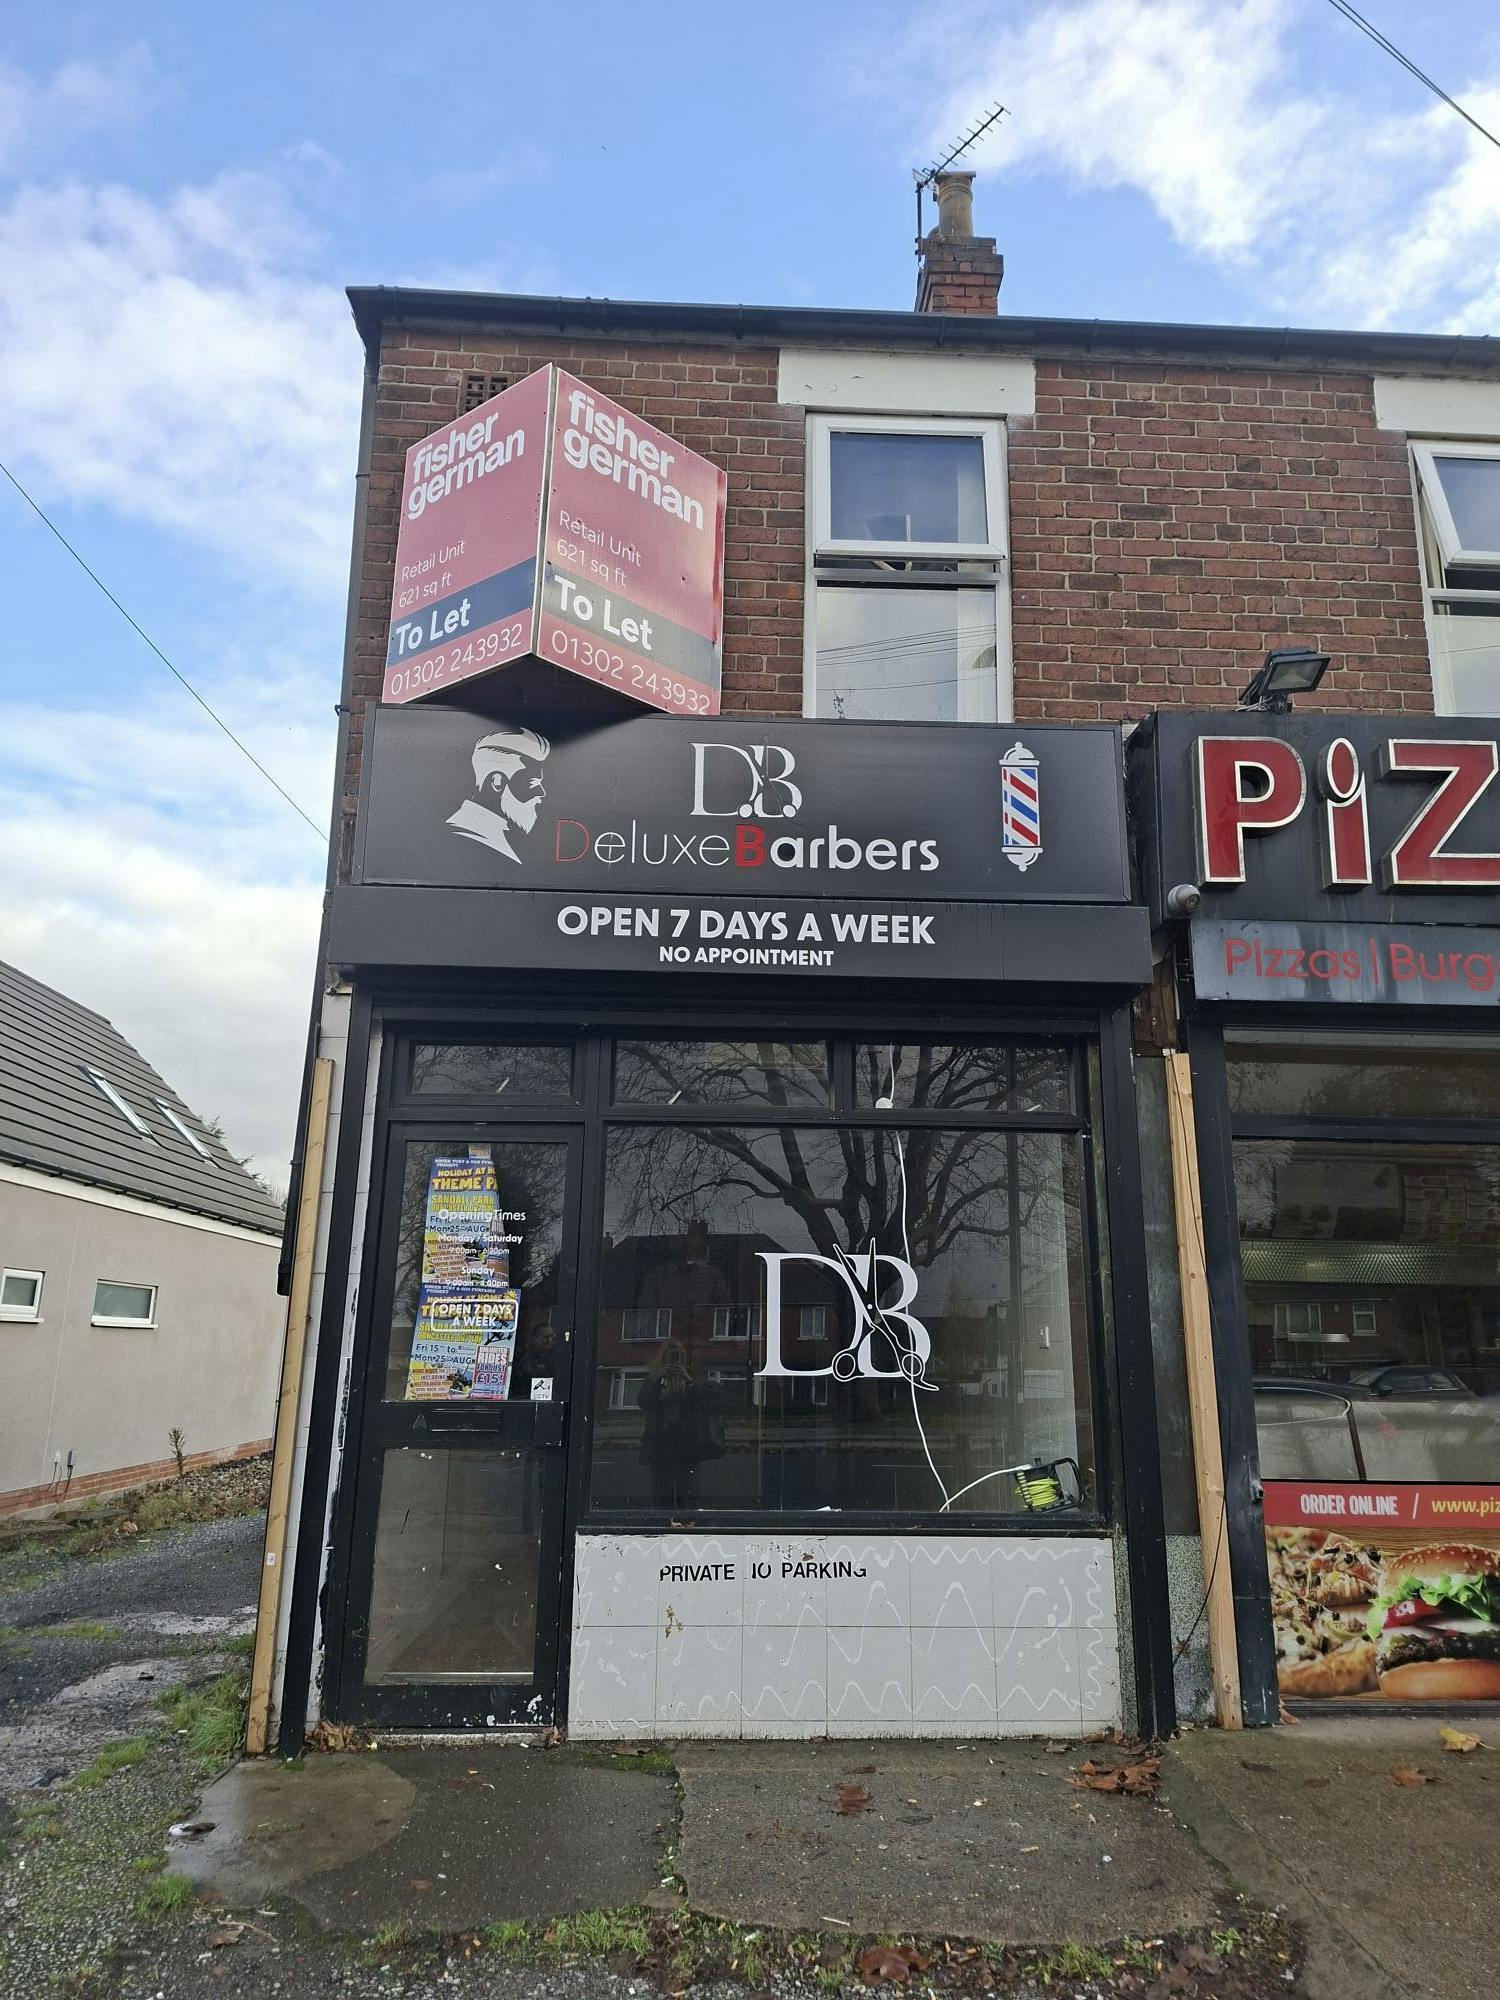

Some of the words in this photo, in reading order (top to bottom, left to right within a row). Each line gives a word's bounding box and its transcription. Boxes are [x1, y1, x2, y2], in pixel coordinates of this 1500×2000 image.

[413, 413, 498, 483] fisher
[568, 390, 674, 479] fisher
[408, 429, 525, 520] german
[563, 428, 704, 529] german
[560, 510, 604, 547] Retail
[610, 539, 642, 567] Unit
[402, 552, 435, 582] Retail
[439, 539, 465, 565] Unit
[557, 539, 585, 568] 621
[591, 558, 609, 579] sq
[615, 567, 627, 587] ft
[399, 585, 420, 608] 621
[423, 582, 437, 600] sq
[441, 571, 452, 589] ft
[396, 623, 422, 655] To
[430, 598, 471, 641] Let
[555, 575, 593, 622] To
[603, 599, 652, 650] Let
[391, 655, 444, 696] 01302
[450, 623, 522, 673] 243932
[551, 629, 625, 680] 01302
[631, 664, 711, 716] 243932
[557, 905, 660, 938] OPEN
[670, 909, 691, 938] 7
[700, 910, 788, 941] DAYS
[797, 913, 821, 942] A
[831, 914, 936, 945] WEEK
[659, 946, 691, 963] NO
[694, 946, 835, 967] APPOINTMENT
[1389, 943, 1500, 992] Burg
[433, 1177, 482, 1191] THEME
[438, 1233, 476, 1243] Monday
[483, 1233, 523, 1244] Saturday
[461, 1266, 495, 1277] Sunday
[439, 1303, 471, 1315] OPEN
[483, 1304, 512, 1315] DAYS
[453, 1317, 460, 1327] A
[464, 1317, 496, 1327] WEEK
[416, 1343, 428, 1352] Fri
[447, 1345, 456, 1353] to
[452, 1356, 472, 1365] AUG
[478, 1352, 508, 1366] RIDES
[1300, 1493, 1346, 1515] ORDER
[1349, 1495, 1399, 1516] ONLINE
[660, 1564, 736, 1582] PRIVATE
[782, 1561, 867, 1579] PARKING
